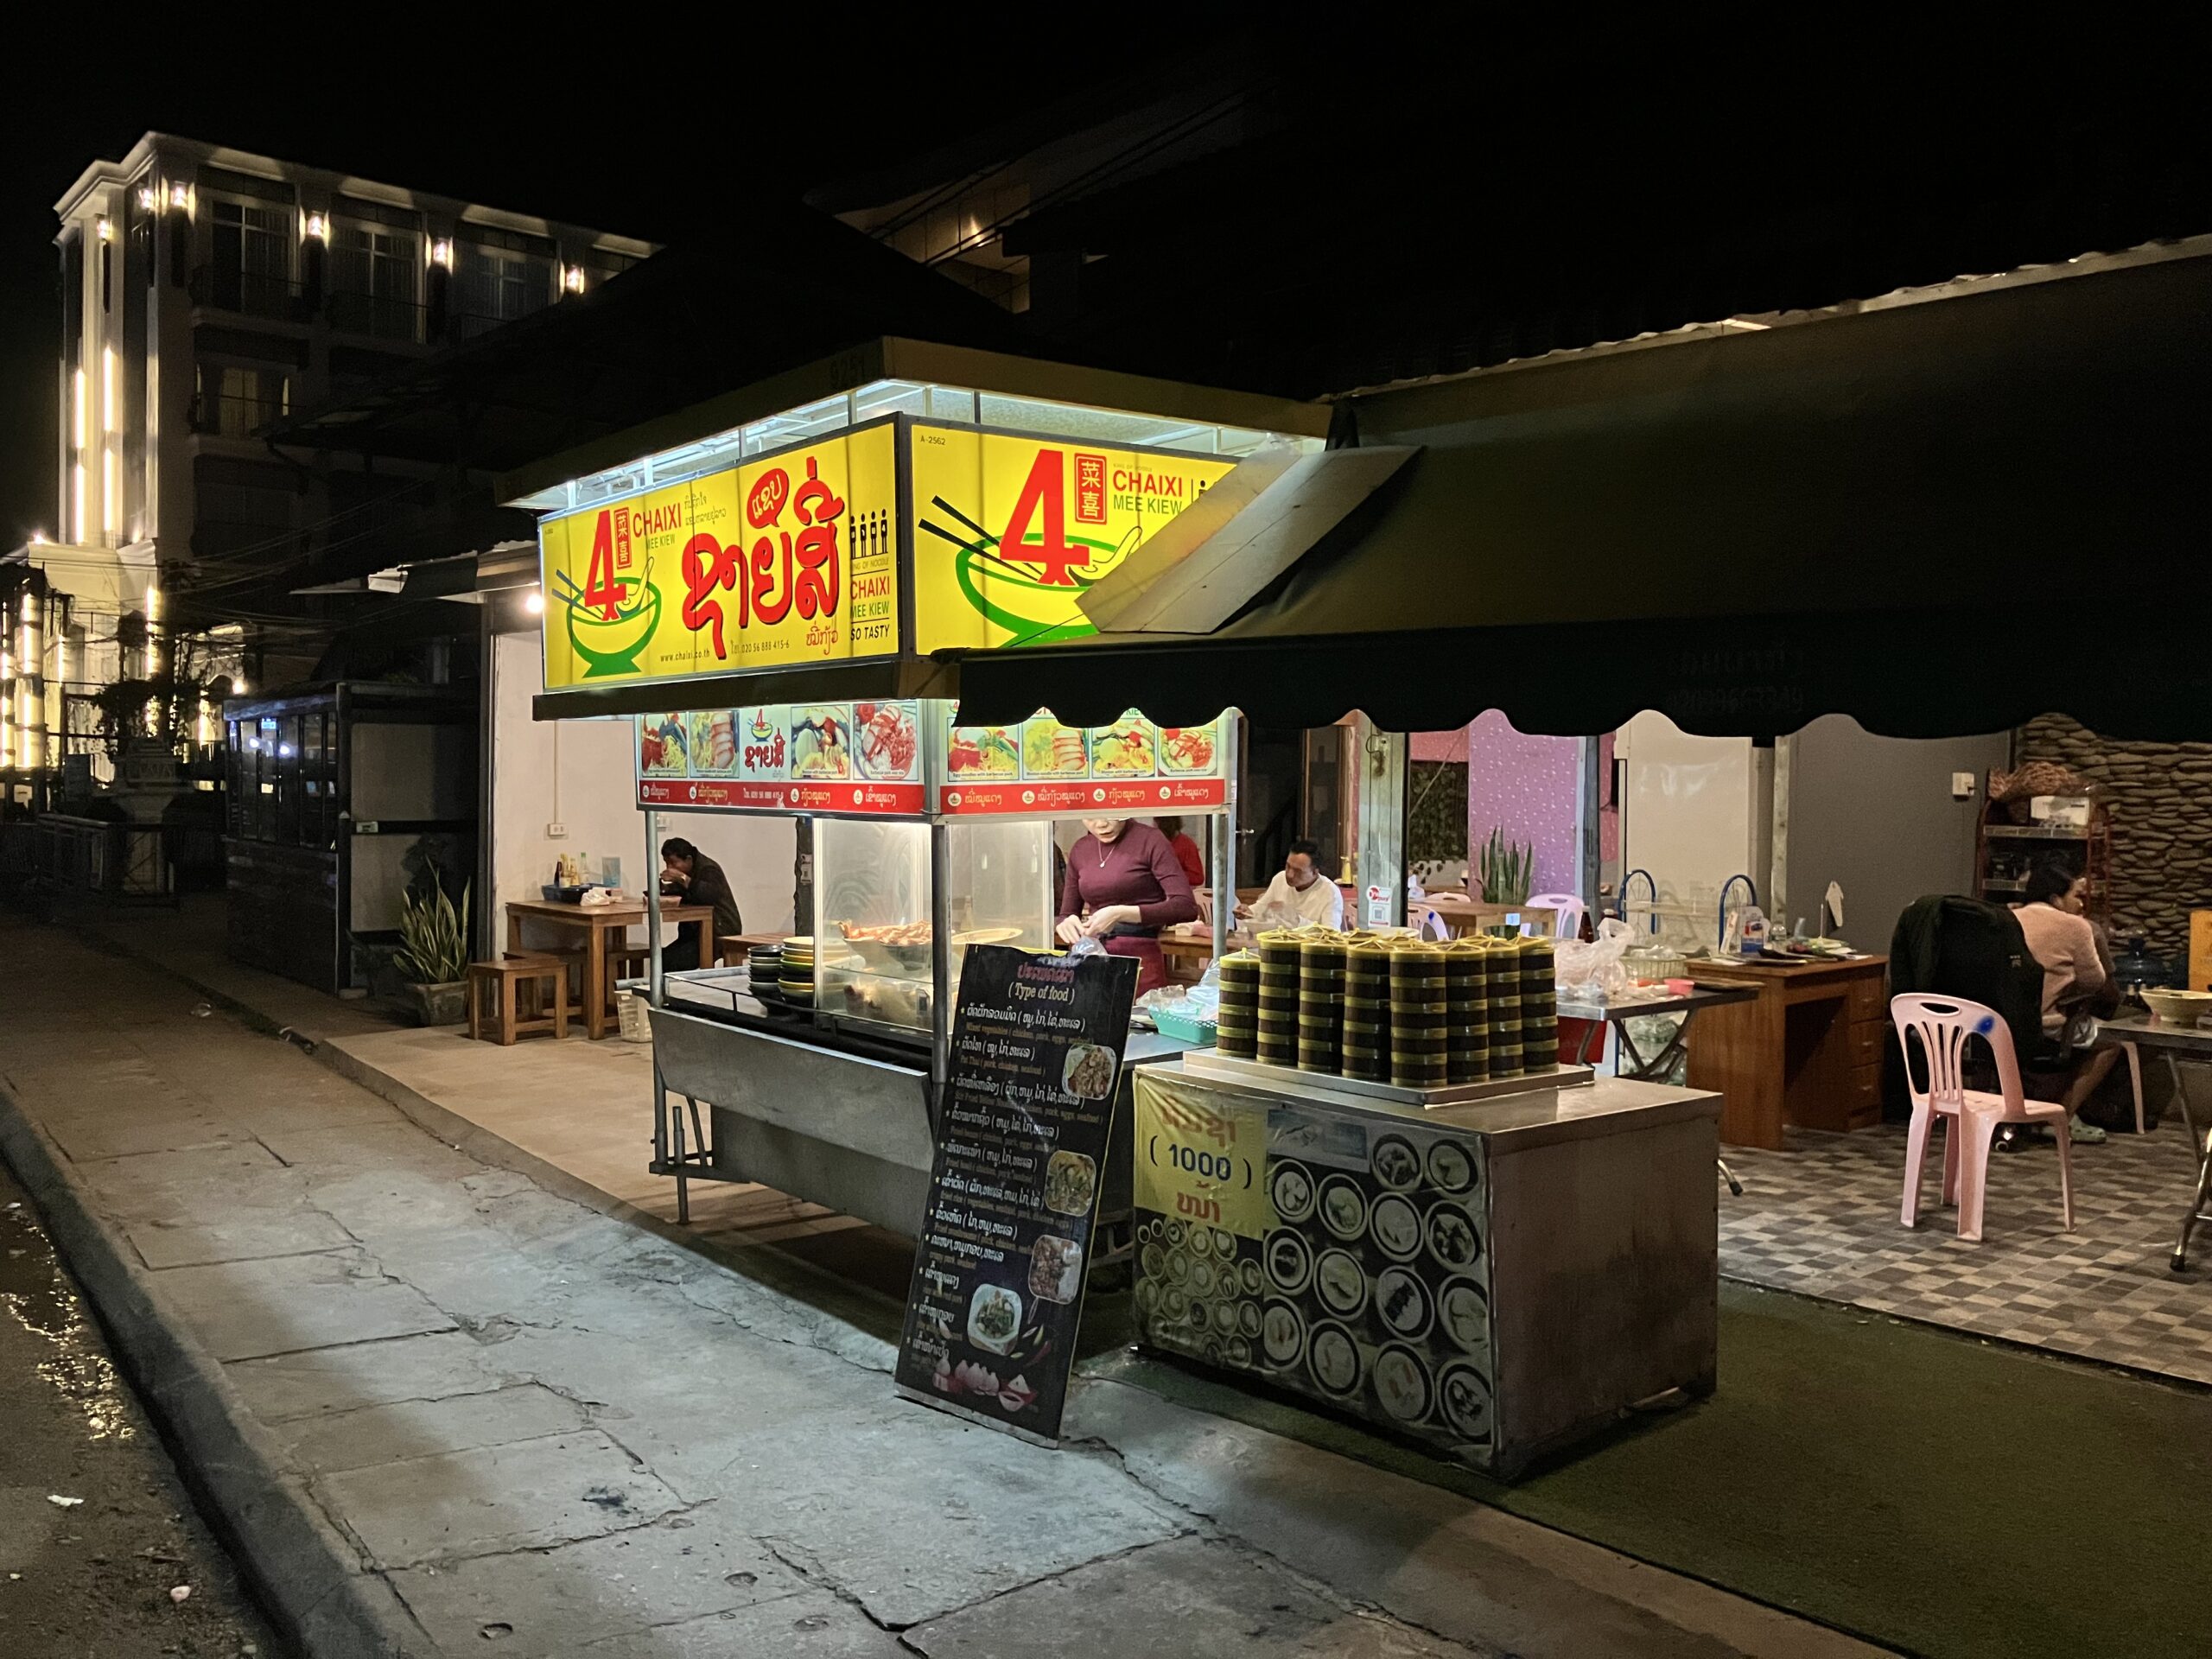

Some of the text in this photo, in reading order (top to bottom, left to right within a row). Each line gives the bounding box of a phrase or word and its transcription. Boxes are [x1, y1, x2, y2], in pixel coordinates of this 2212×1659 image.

[1081, 461, 1102, 519] 菜喜
[1112, 469, 1183, 497] CHAIXI
[1000, 449, 1090, 586] 4
[1113, 494, 1183, 516] MEE KIEW
[632, 502, 682, 538] CHAIXI
[616, 512, 628, 566] 菜喜
[645, 533, 676, 550] MEE KIEW
[584, 509, 628, 621] 4
[850, 575, 890, 601] CHAIXI
[851, 601, 890, 619] MEE KIEW
[753, 643, 760, 652] 56
[761, 641, 772, 652] 888
[772, 639, 790, 650] 415-6
[850, 624, 890, 641] SO TASTY
[660, 648, 710, 663] www.chaixi.co.th
[1014, 982, 1036, 1001] Type
[1037, 985, 1049, 1000] of
[1048, 985, 1070, 1001] food
[1168, 1143, 1231, 1181] 1000
